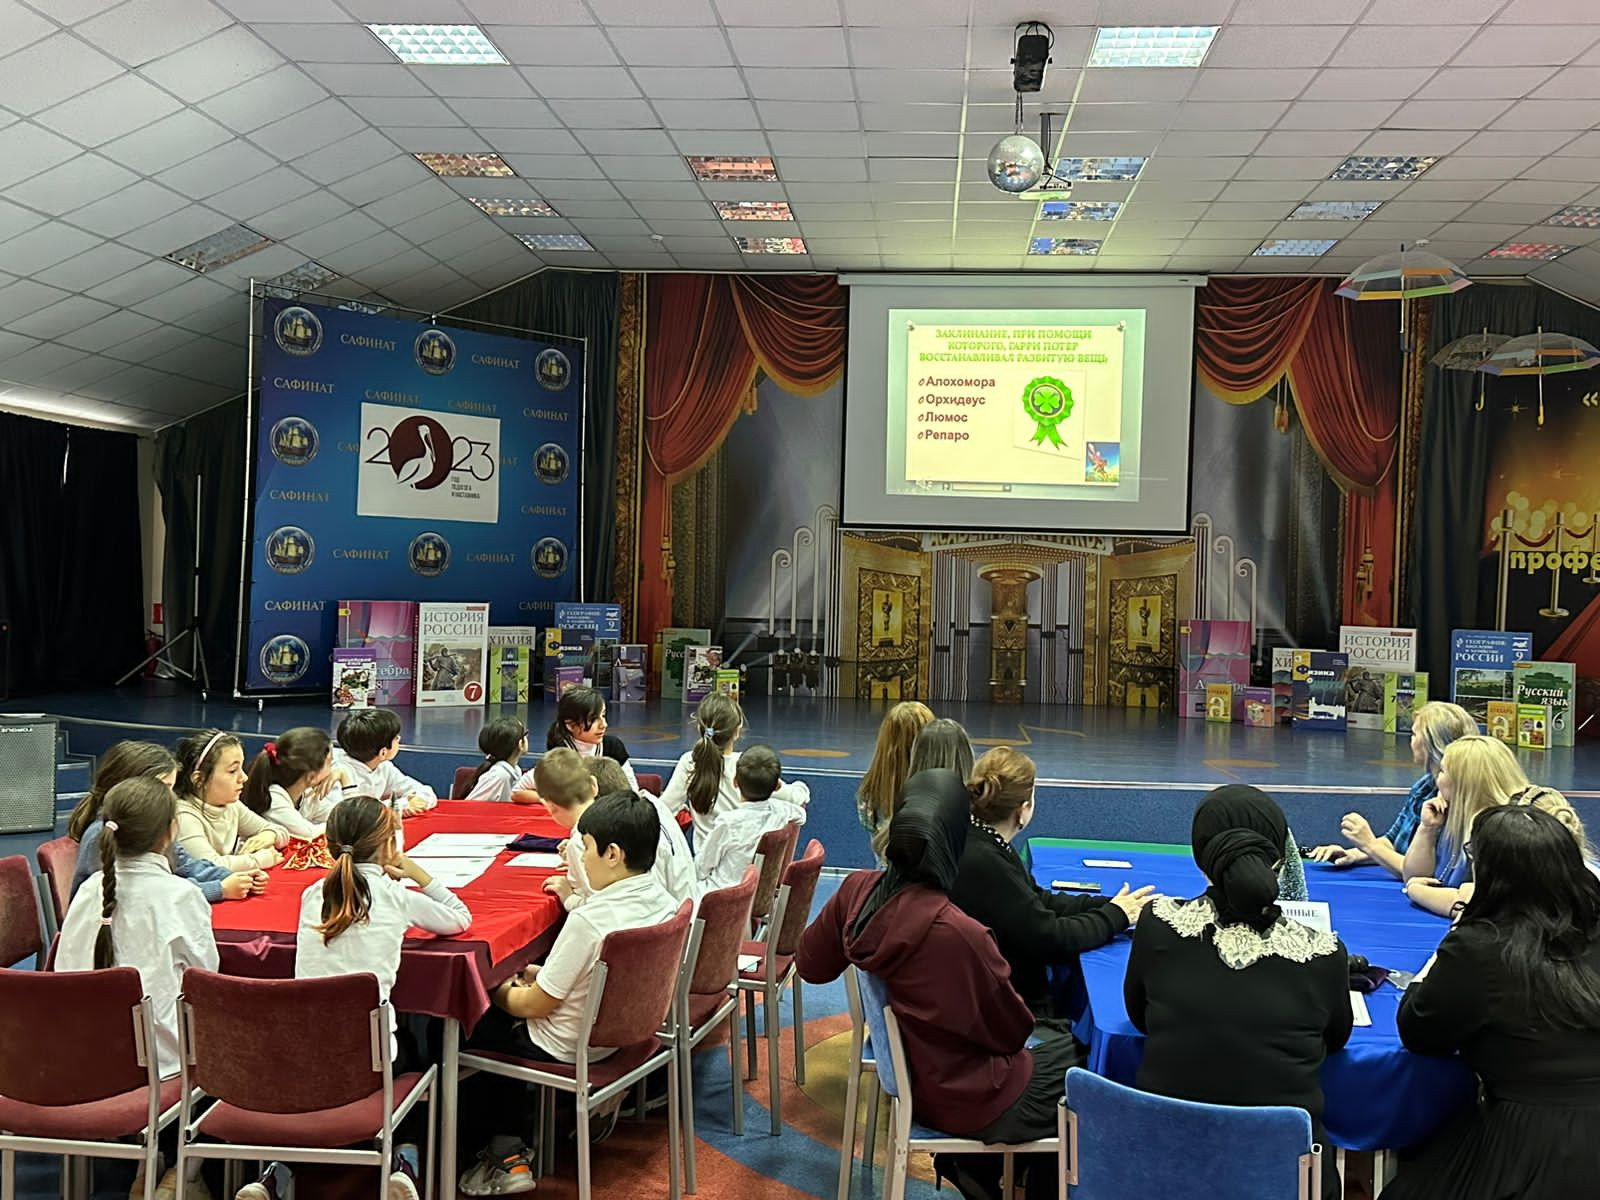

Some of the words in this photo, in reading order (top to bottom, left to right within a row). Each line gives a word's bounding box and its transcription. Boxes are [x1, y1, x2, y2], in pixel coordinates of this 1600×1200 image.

[936, 329, 1011, 339] ЗАКЛИНАНИЕ,
[1013, 329, 1035, 339] ПРИ
[1038, 329, 1092, 340] ПОМОЩИ
[340, 333, 397, 352] САФИНАТ
[948, 341, 1007, 351] КОТОРОГО,
[1009, 341, 1041, 351] ГАРРИ
[1043, 341, 1079, 351] ПОТЕР
[471, 354, 520, 369] САФИНАТ
[919, 353, 1014, 362] ВОССТАНАВЛИВАЛ
[1016, 353, 1076, 363] РАЗБИТУЮ
[1077, 353, 1108, 364] ВЕЩЬ
[273, 376, 334, 395] САФИНАТ
[926, 375, 996, 390] Алохомора
[925, 393, 986, 408] Орхидеус
[522, 407, 568, 423] САФИНАТ
[925, 411, 968, 423] Люмос
[925, 428, 970, 443] Репаро
[269, 488, 329, 503] САФИНАТ
[520, 504, 567, 518] САФИНАТ
[332, 548, 390, 561] САФИНАТ
[466, 553, 516, 564] САФИНАТ
[264, 600, 326, 612] САФИНАТ
[423, 612, 485, 623] ИСТОРИЯ
[423, 623, 484, 637] РОССИИ
[489, 635, 533, 647] ХИМИЯ
[1343, 635, 1411, 650] ИСТОРИЯ
[665, 648, 685, 661] Русс
[1343, 646, 1411, 662] РОССИИ
[1455, 652, 1504, 664] РОССИИ
[467, 685, 479, 700] 7
[1516, 683, 1564, 699] Русский
[1540, 697, 1569, 707] язык
[1552, 709, 1570, 731] 6
